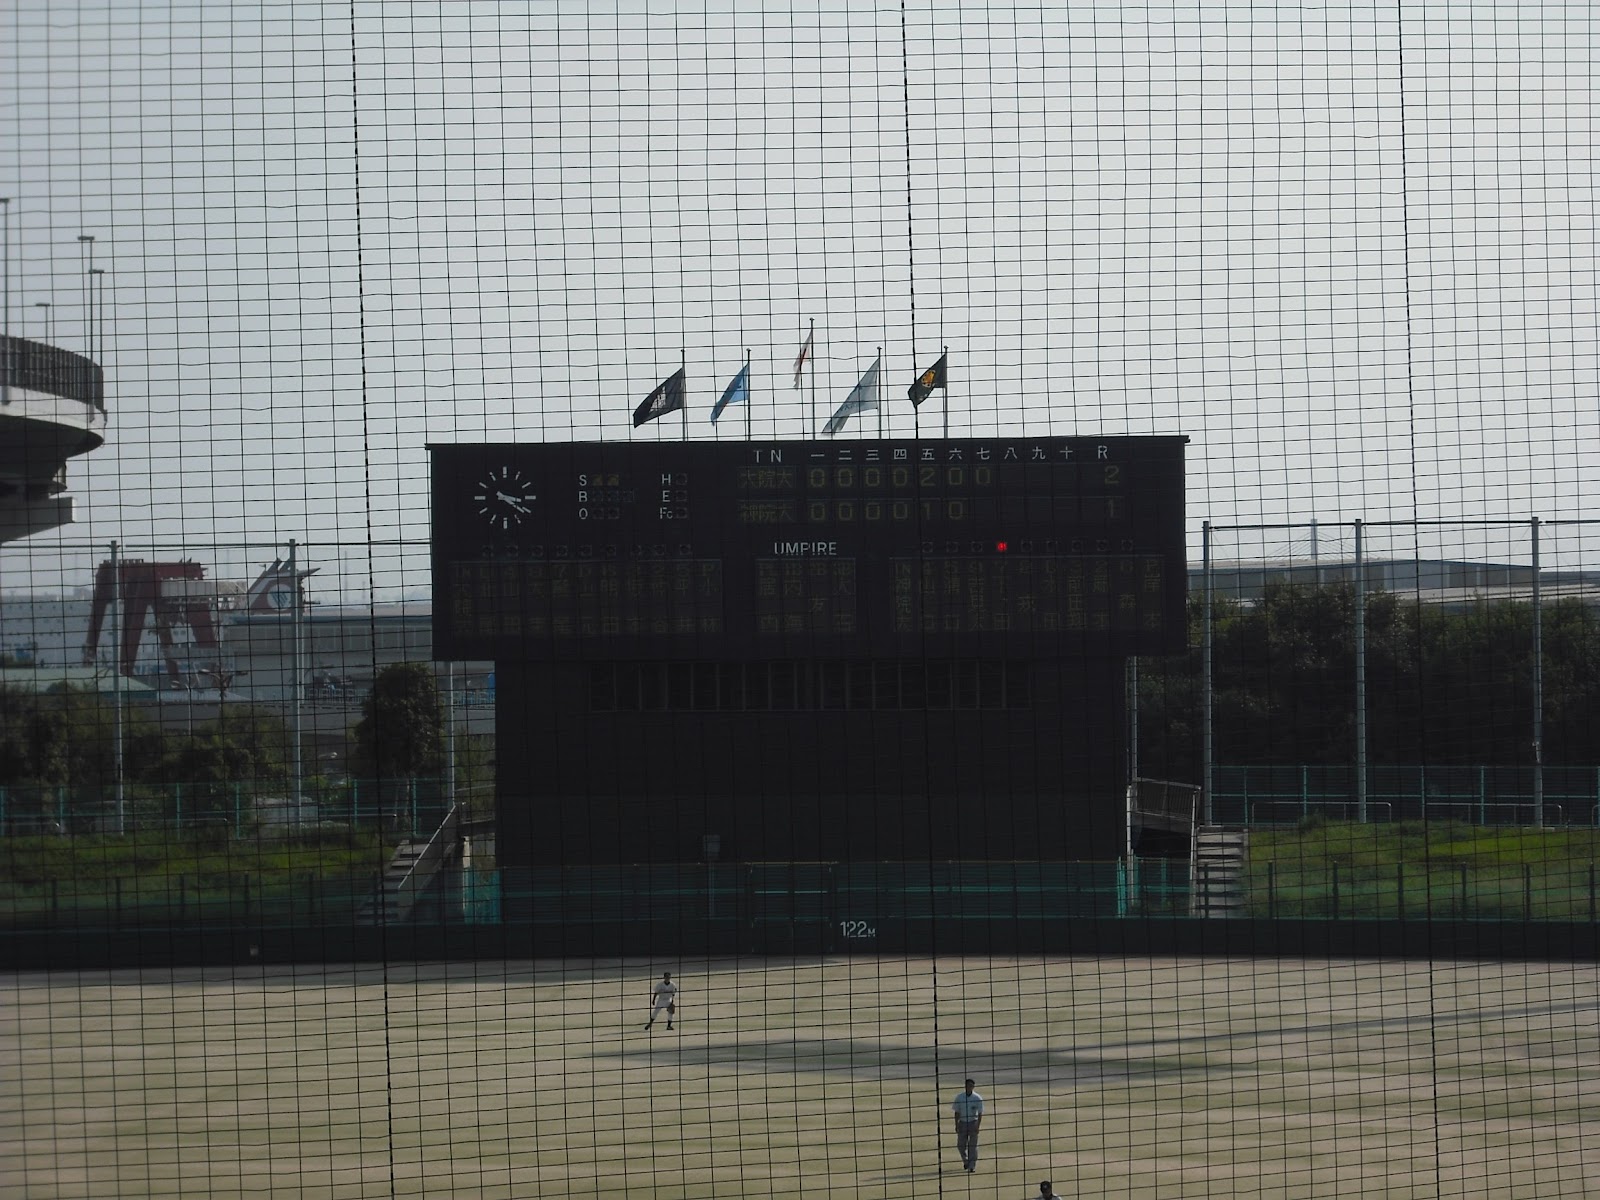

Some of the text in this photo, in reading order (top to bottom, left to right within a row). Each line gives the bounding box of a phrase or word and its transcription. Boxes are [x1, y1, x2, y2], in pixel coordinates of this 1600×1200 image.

[838, 449, 852, 461] 二
[865, 449, 880, 461] 三
[893, 448, 907, 460] 四
[920, 448, 935, 461] 五
[948, 448, 963, 460] 六
[976, 447, 990, 460] 七
[1004, 447, 1018, 460] 八
[1031, 446, 1046, 460] 九
[1059, 446, 1073, 460] 十
[1097, 445, 1108, 460] R
[578, 473, 588, 487] S
[661, 473, 671, 486] H
[921, 467, 936, 487] 2
[1104, 465, 1120, 485] 2
[578, 490, 588, 503] B
[662, 490, 671, 503] E
[774, 541, 838, 556] UMPIRE
